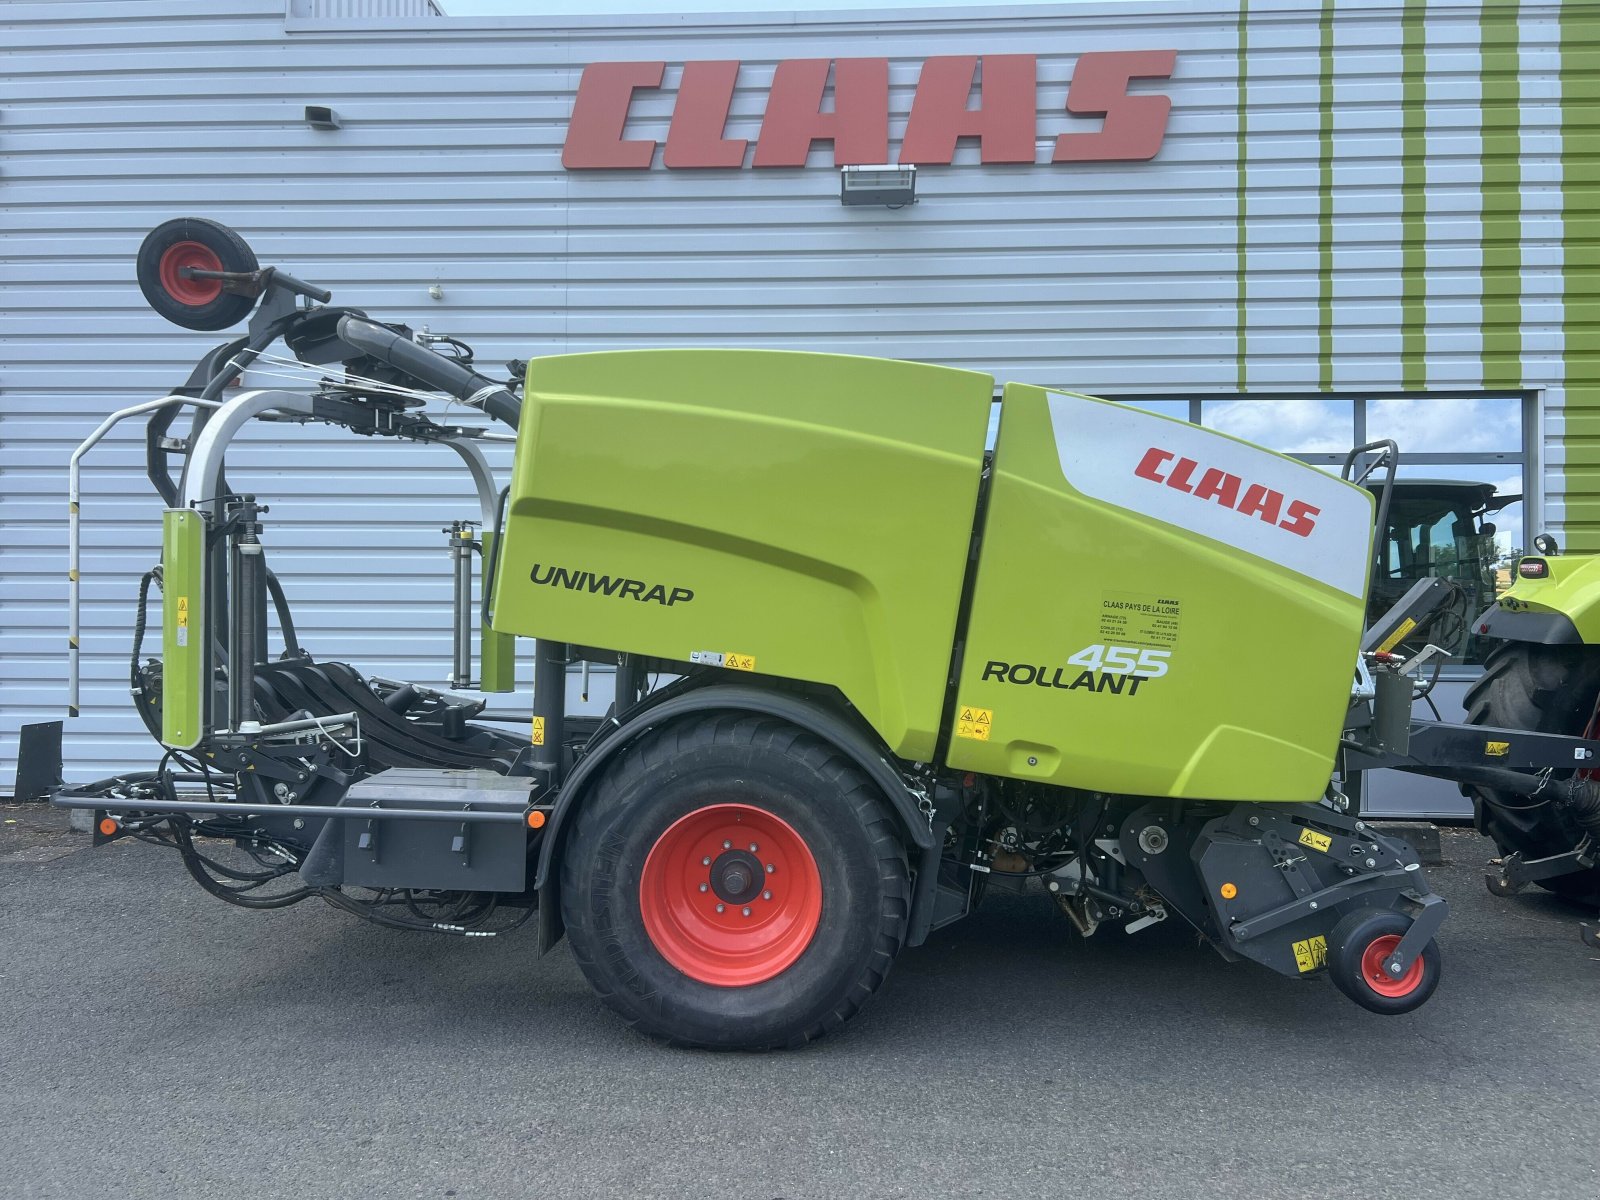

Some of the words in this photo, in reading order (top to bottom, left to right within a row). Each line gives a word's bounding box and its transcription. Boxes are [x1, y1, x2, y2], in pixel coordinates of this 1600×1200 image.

[561, 49, 1179, 170] CLAAS
[1134, 447, 1321, 538] CLAAS
[530, 564, 694, 607] UNIWRAP
[1103, 600, 1124, 610] CLAAS
[1125, 603, 1141, 611] PAYS
[1161, 607, 1180, 615] LOIRE
[981, 661, 1149, 696] ROLLANT
[1067, 644, 1172, 678] 455
